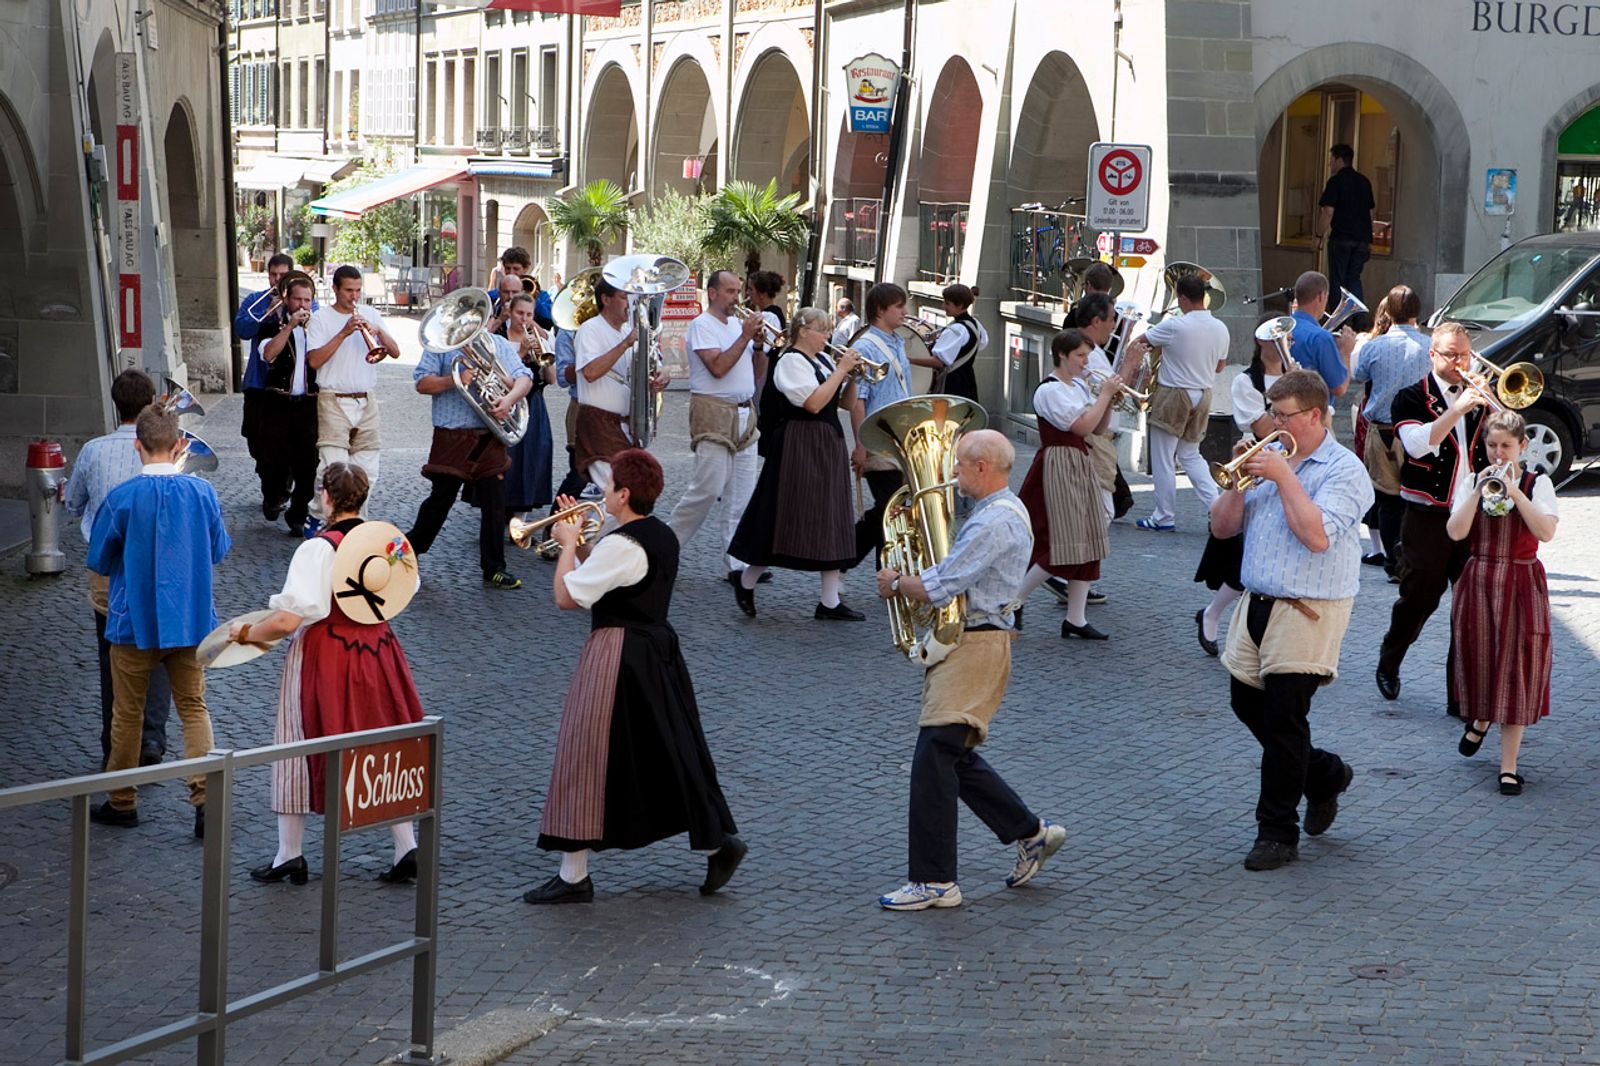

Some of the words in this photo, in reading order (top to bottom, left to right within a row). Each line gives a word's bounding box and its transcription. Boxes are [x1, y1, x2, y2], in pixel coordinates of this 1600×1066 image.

[1471, 0, 1600, 36] BURGD
[850, 67, 896, 80] Restaurant
[122, 104, 132, 119] AG
[855, 110, 888, 121] BAR
[125, 231, 134, 251] BAU
[125, 252, 134, 268] AG
[1121, 259, 1128, 267] 4
[358, 751, 425, 809] Schloss
